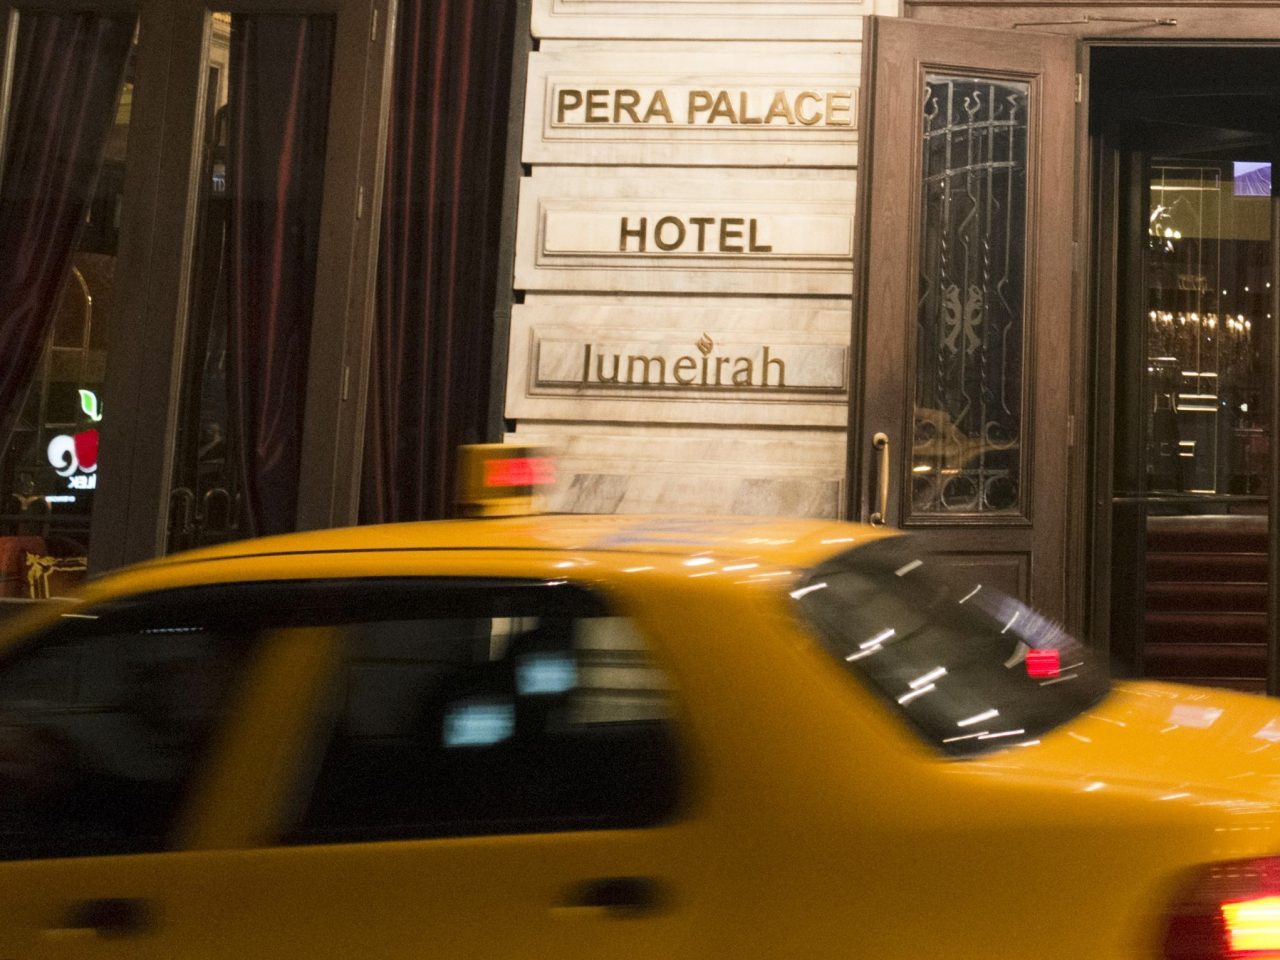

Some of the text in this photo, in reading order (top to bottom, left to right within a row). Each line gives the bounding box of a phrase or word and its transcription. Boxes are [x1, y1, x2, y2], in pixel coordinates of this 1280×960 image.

[557, 88, 852, 126] PERA PALACE
[619, 215, 773, 253] HOTEL
[577, 332, 787, 393] Jumeirah
